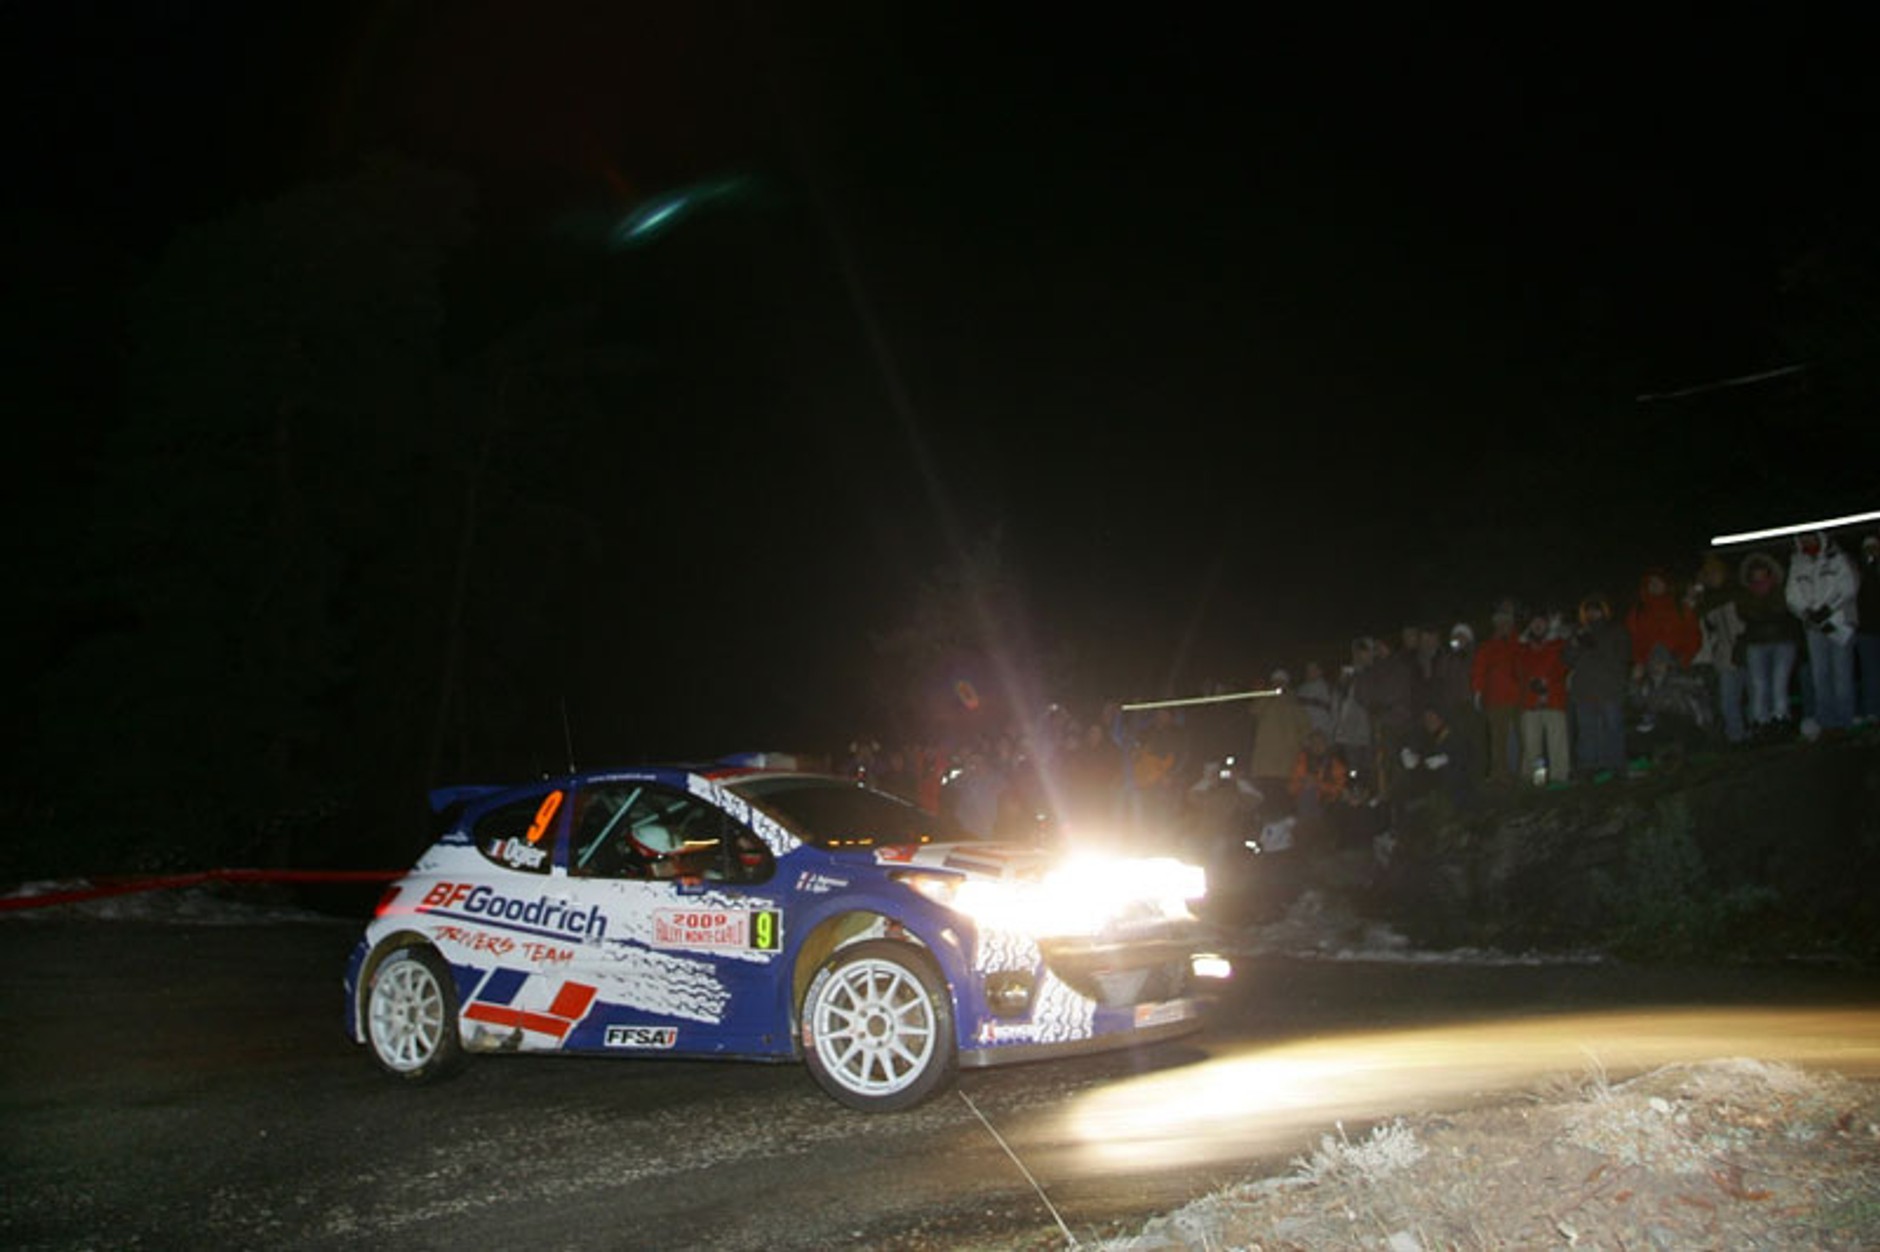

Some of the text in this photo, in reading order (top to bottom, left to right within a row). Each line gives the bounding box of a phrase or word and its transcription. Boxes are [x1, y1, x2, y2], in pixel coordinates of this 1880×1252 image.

[527, 789, 564, 844] 9
[422, 881, 608, 938] BFGoodrich
[673, 913, 728, 929] 2009
[757, 911, 773, 950] 9
[521, 941, 575, 967] TEAM
[607, 1027, 667, 1045] FFSA
